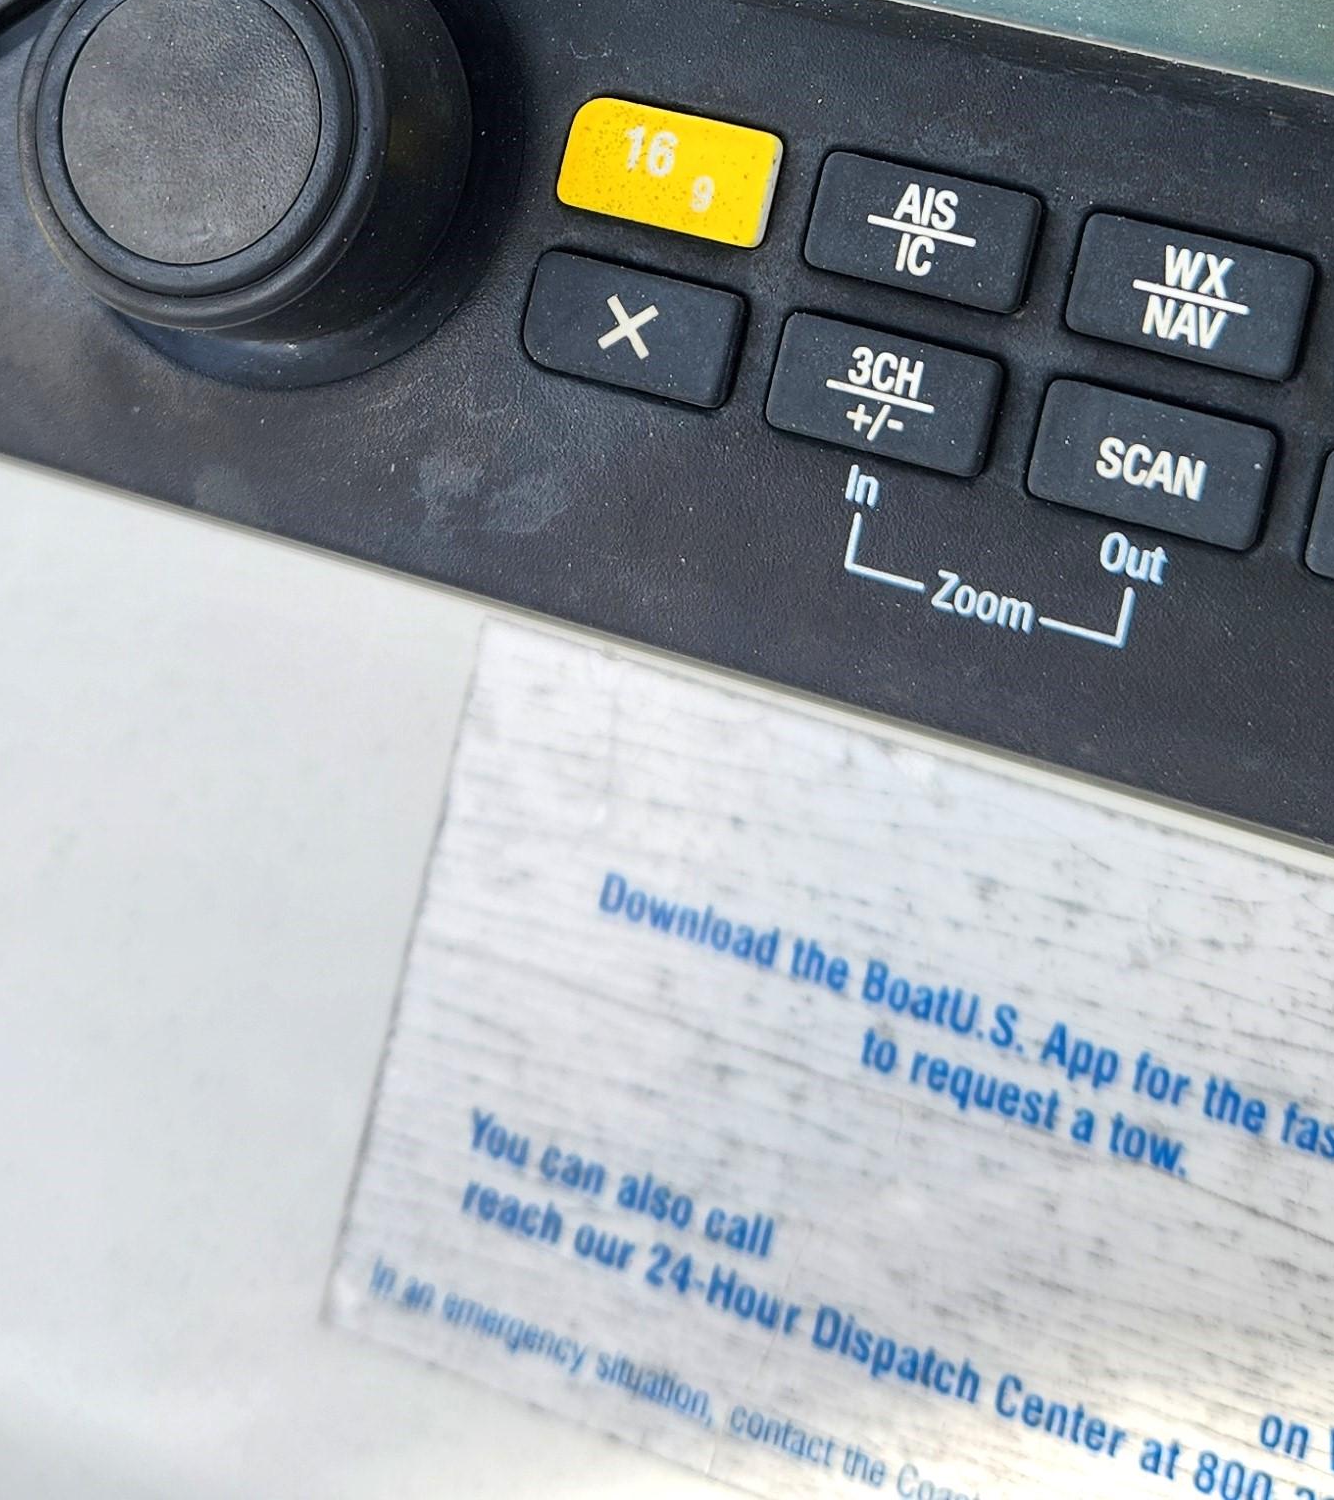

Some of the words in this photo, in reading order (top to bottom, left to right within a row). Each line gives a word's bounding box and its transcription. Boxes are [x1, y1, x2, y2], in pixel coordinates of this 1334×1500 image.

[623, 125, 676, 177] 16
[689, 177, 715, 213] 9
[892, 184, 959, 232] AIS
[895, 230, 935, 278] IC
[1161, 245, 1235, 299] WX
[1140, 297, 1229, 351] NAV
[847, 345, 925, 399] 3CH
[844, 466, 881, 508] In
[1095, 437, 1207, 502] SCAN
[1098, 532, 1168, 586] Out
[931, 571, 1035, 633] Zoom
[598, 872, 781, 967] Download
[790, 936, 850, 992] the
[861, 959, 1025, 1054] BoatU.S.
[1040, 1022, 1120, 1090] App
[1132, 1051, 1191, 1106] for
[1202, 1074, 1268, 1135] the
[860, 1026, 898, 1074] to
[909, 1052, 1062, 1132] request
[1070, 1107, 1095, 1143] a
[1109, 1113, 1189, 1177] tow.
[470, 1108, 530, 1168] You
[539, 1143, 607, 1195] can
[617, 1173, 694, 1229] also
[704, 1204, 776, 1258] call
[462, 1180, 564, 1245] reach
[573, 1225, 636, 1272] our
[645, 1243, 801, 1336] 24-Hour
[812, 1307, 982, 1404] Dispatch
[995, 1373, 1127, 1458] Center
[1139, 1436, 1182, 1480] at
[370, 1256, 396, 1294] In
[403, 1274, 435, 1311] an
[442, 1293, 589, 1376] emergency
[596, 1349, 714, 1427] situation,
[730, 1403, 834, 1469] contact
[843, 1444, 886, 1489] the
[1259, 1414, 1310, 1460] on
